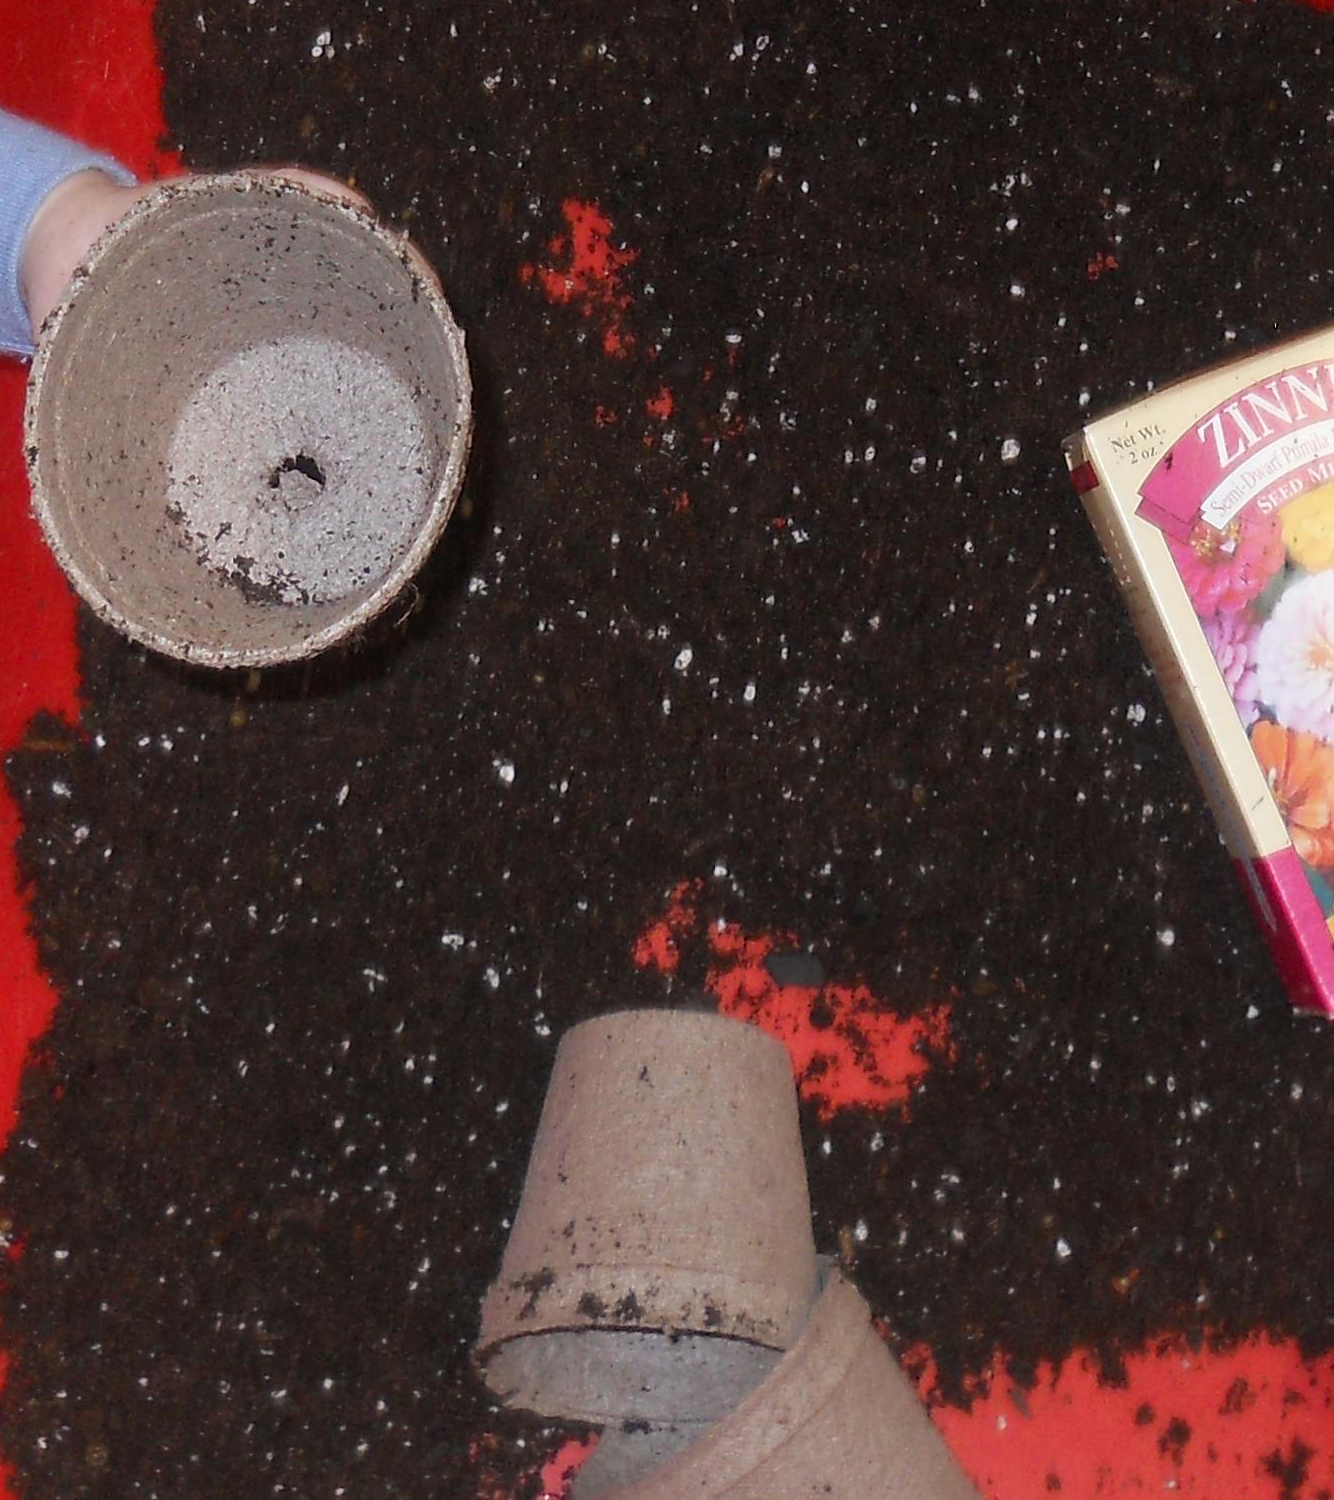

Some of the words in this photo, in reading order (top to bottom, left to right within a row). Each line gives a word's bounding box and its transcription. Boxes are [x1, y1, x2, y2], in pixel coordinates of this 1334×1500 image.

[1112, 431, 1138, 451] Net
[1141, 423, 1166, 443] Wt.
[1257, 478, 1304, 514] SEED
